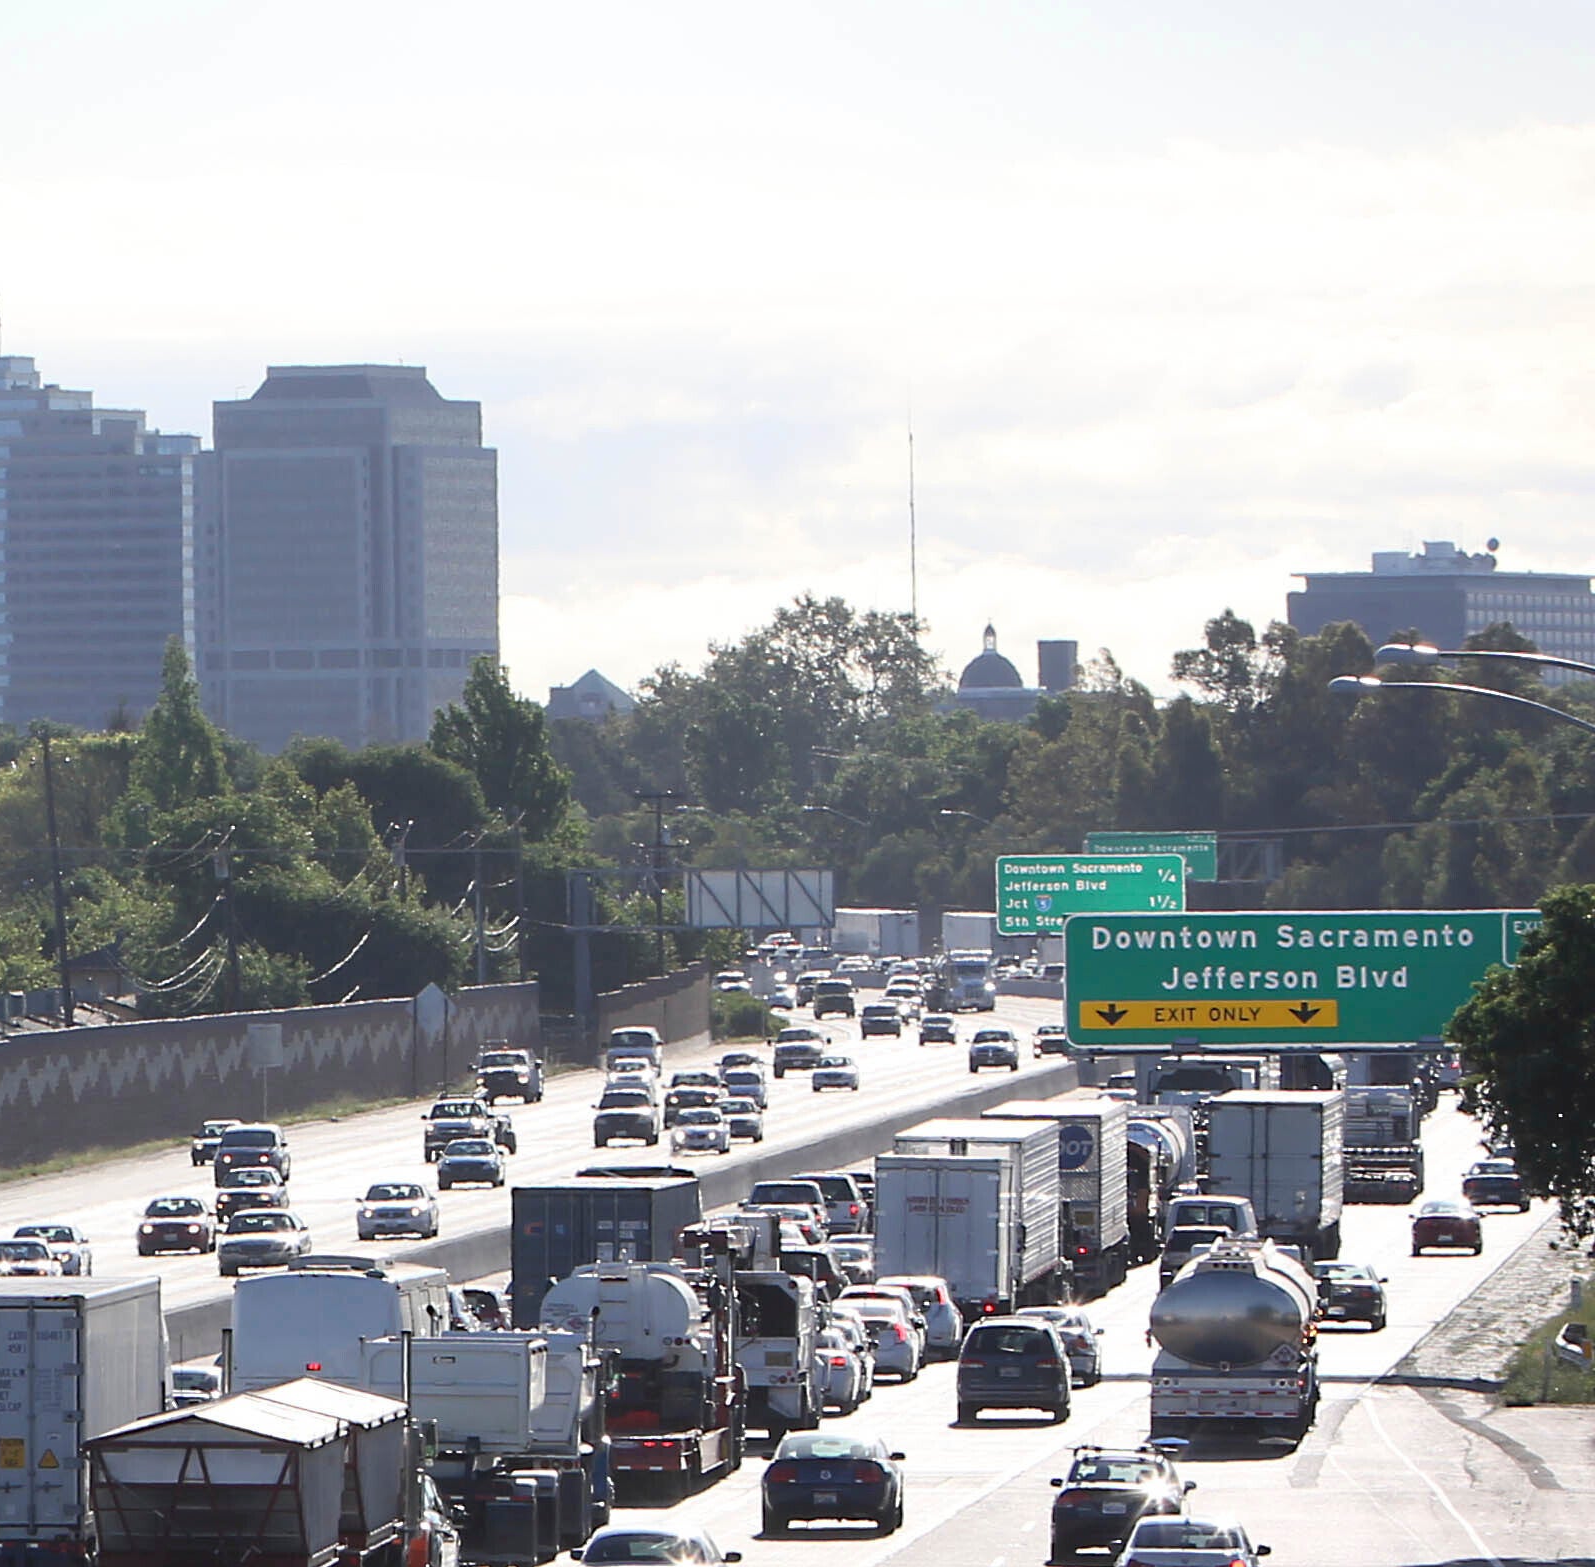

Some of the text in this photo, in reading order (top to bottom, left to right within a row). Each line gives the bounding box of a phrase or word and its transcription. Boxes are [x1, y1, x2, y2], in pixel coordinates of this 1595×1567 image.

[1004, 863, 1143, 874] Downtown Sacramento
[1004, 879, 1107, 892] Jefferson Blvd
[1005, 899, 1029, 909] Jct
[1005, 916, 1063, 927] 5th Stre
[1092, 924, 1475, 950] Downtown Sacramento
[1162, 965, 1407, 990] Jefferson Blvd
[1154, 1006, 1261, 1022] EXIT ONLY
